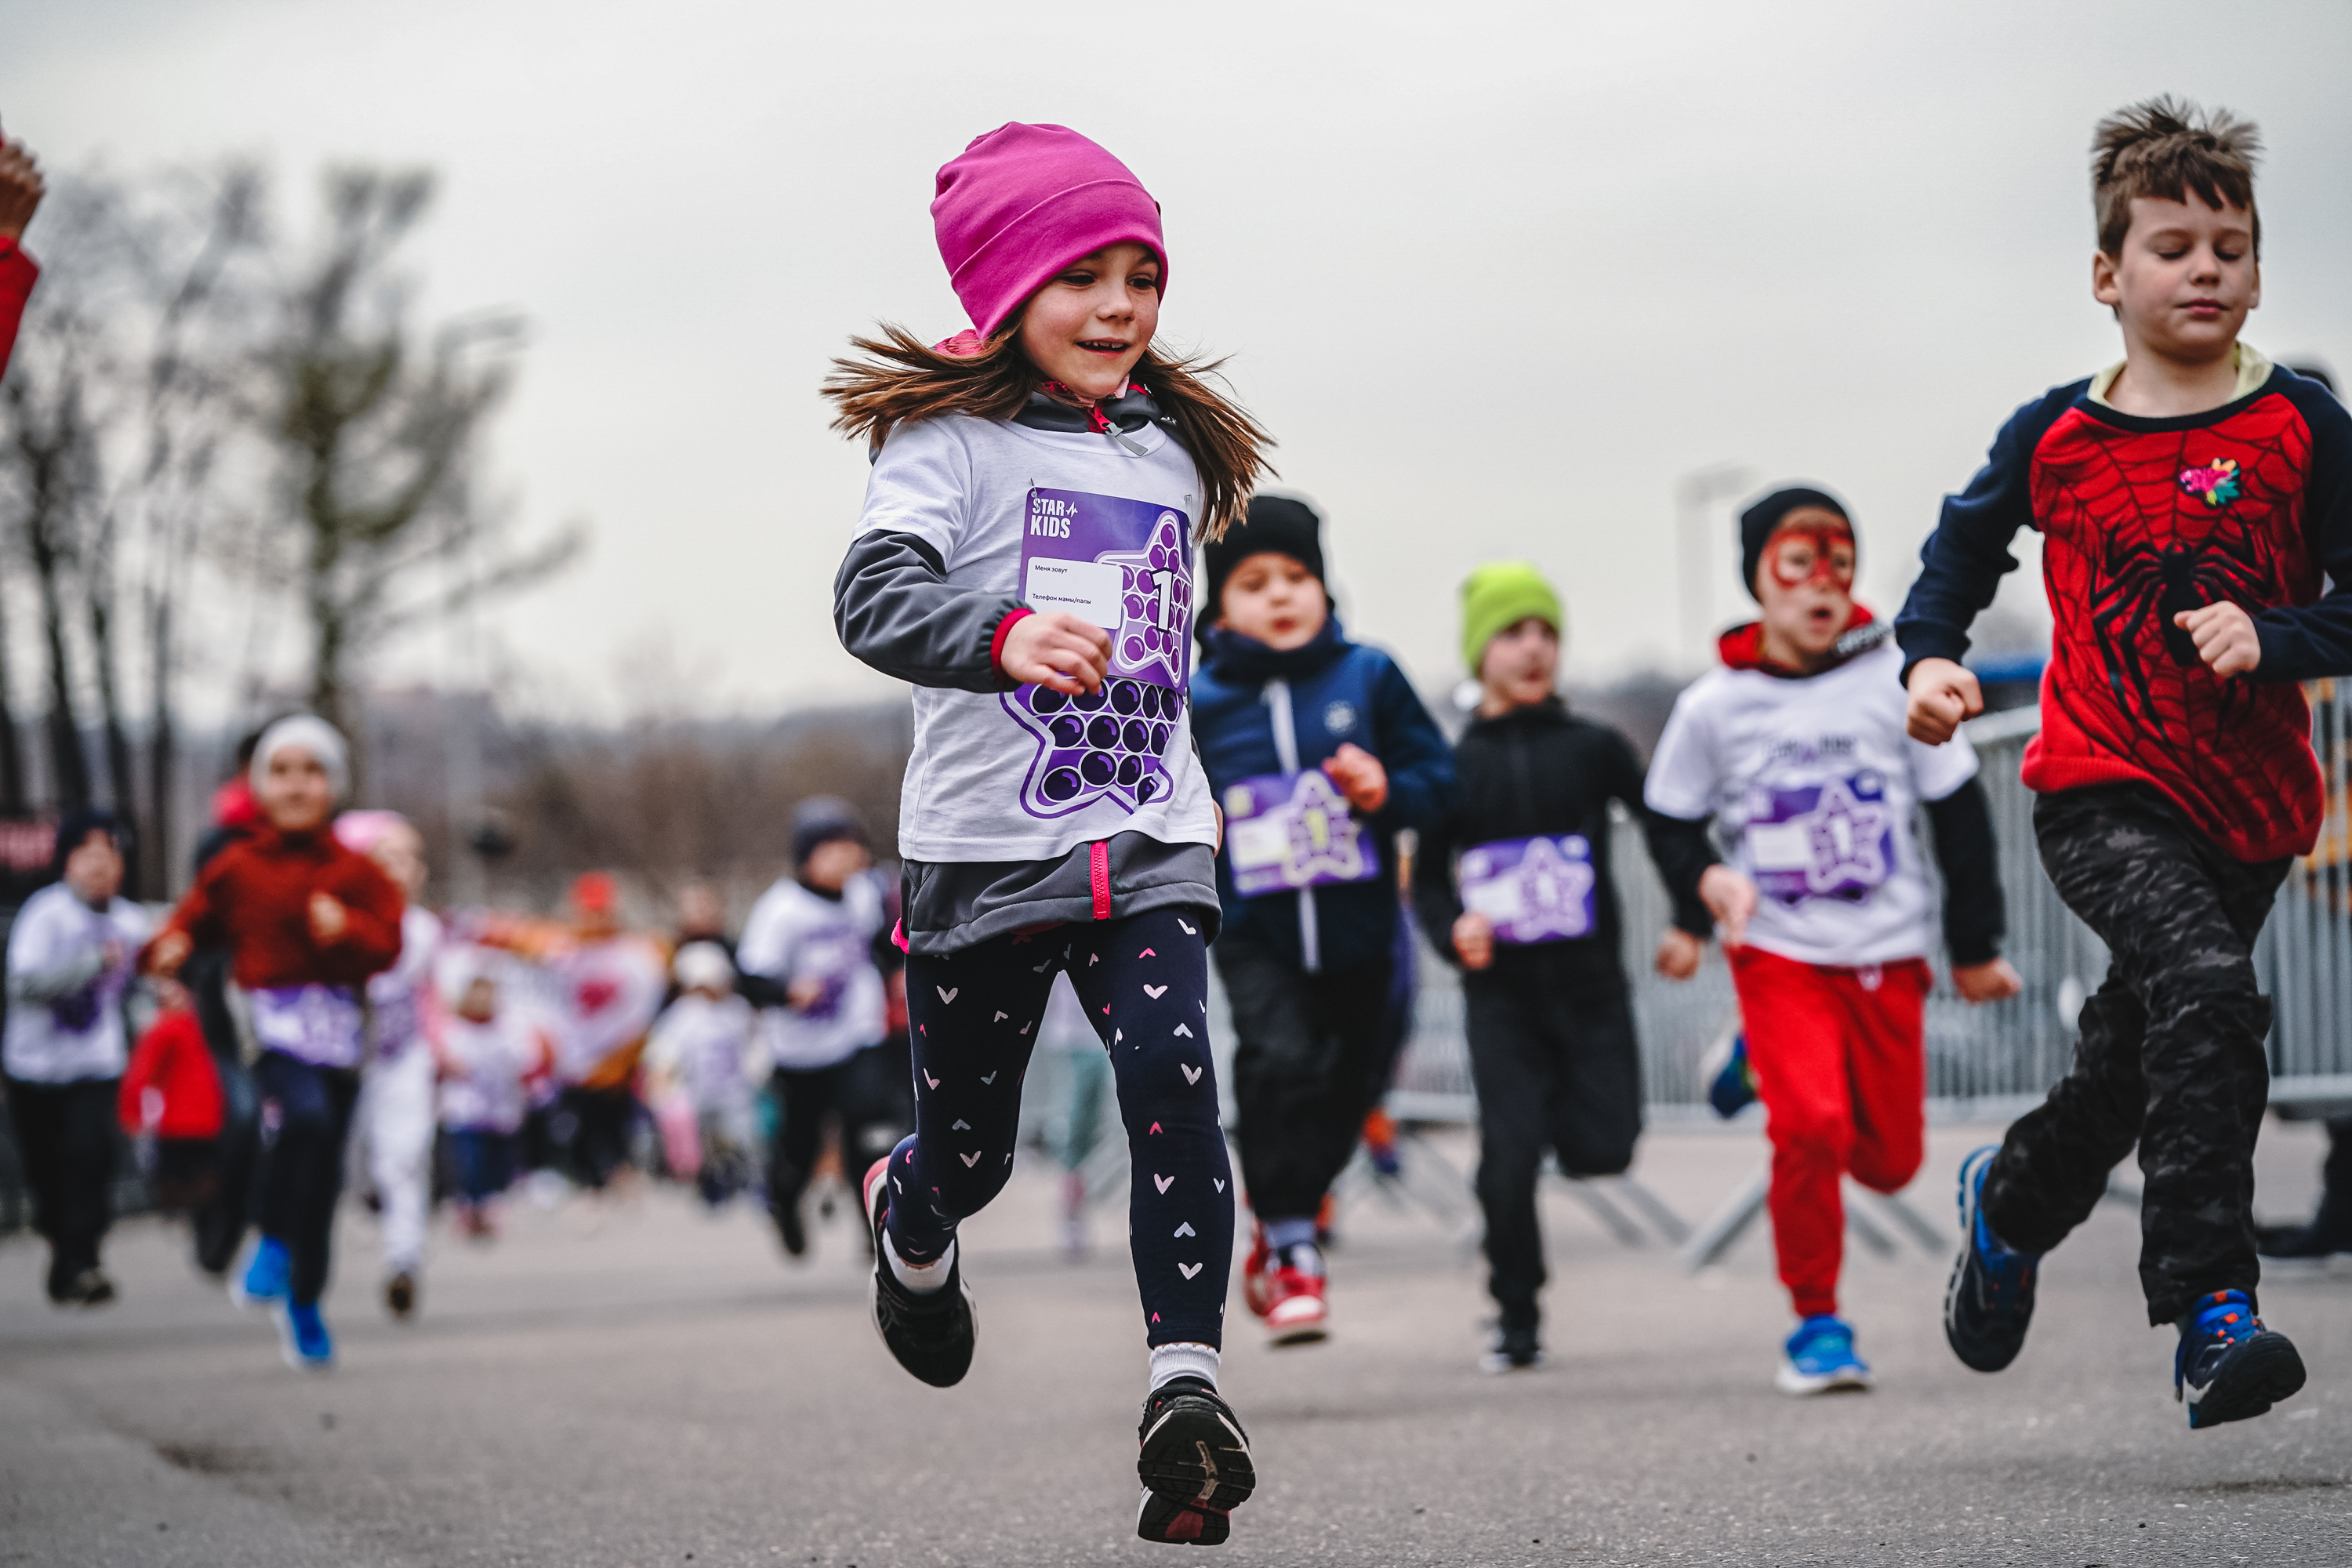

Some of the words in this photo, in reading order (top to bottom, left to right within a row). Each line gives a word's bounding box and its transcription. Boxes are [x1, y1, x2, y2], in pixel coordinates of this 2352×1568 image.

[1032, 497, 1065, 517] STAR
[1029, 514, 1071, 539] KIDS
[1032, 593, 1058, 601] Телефон
[1149, 568, 1174, 633] 1
[1305, 808, 1328, 850] 1
[1831, 815, 1852, 858] 1
